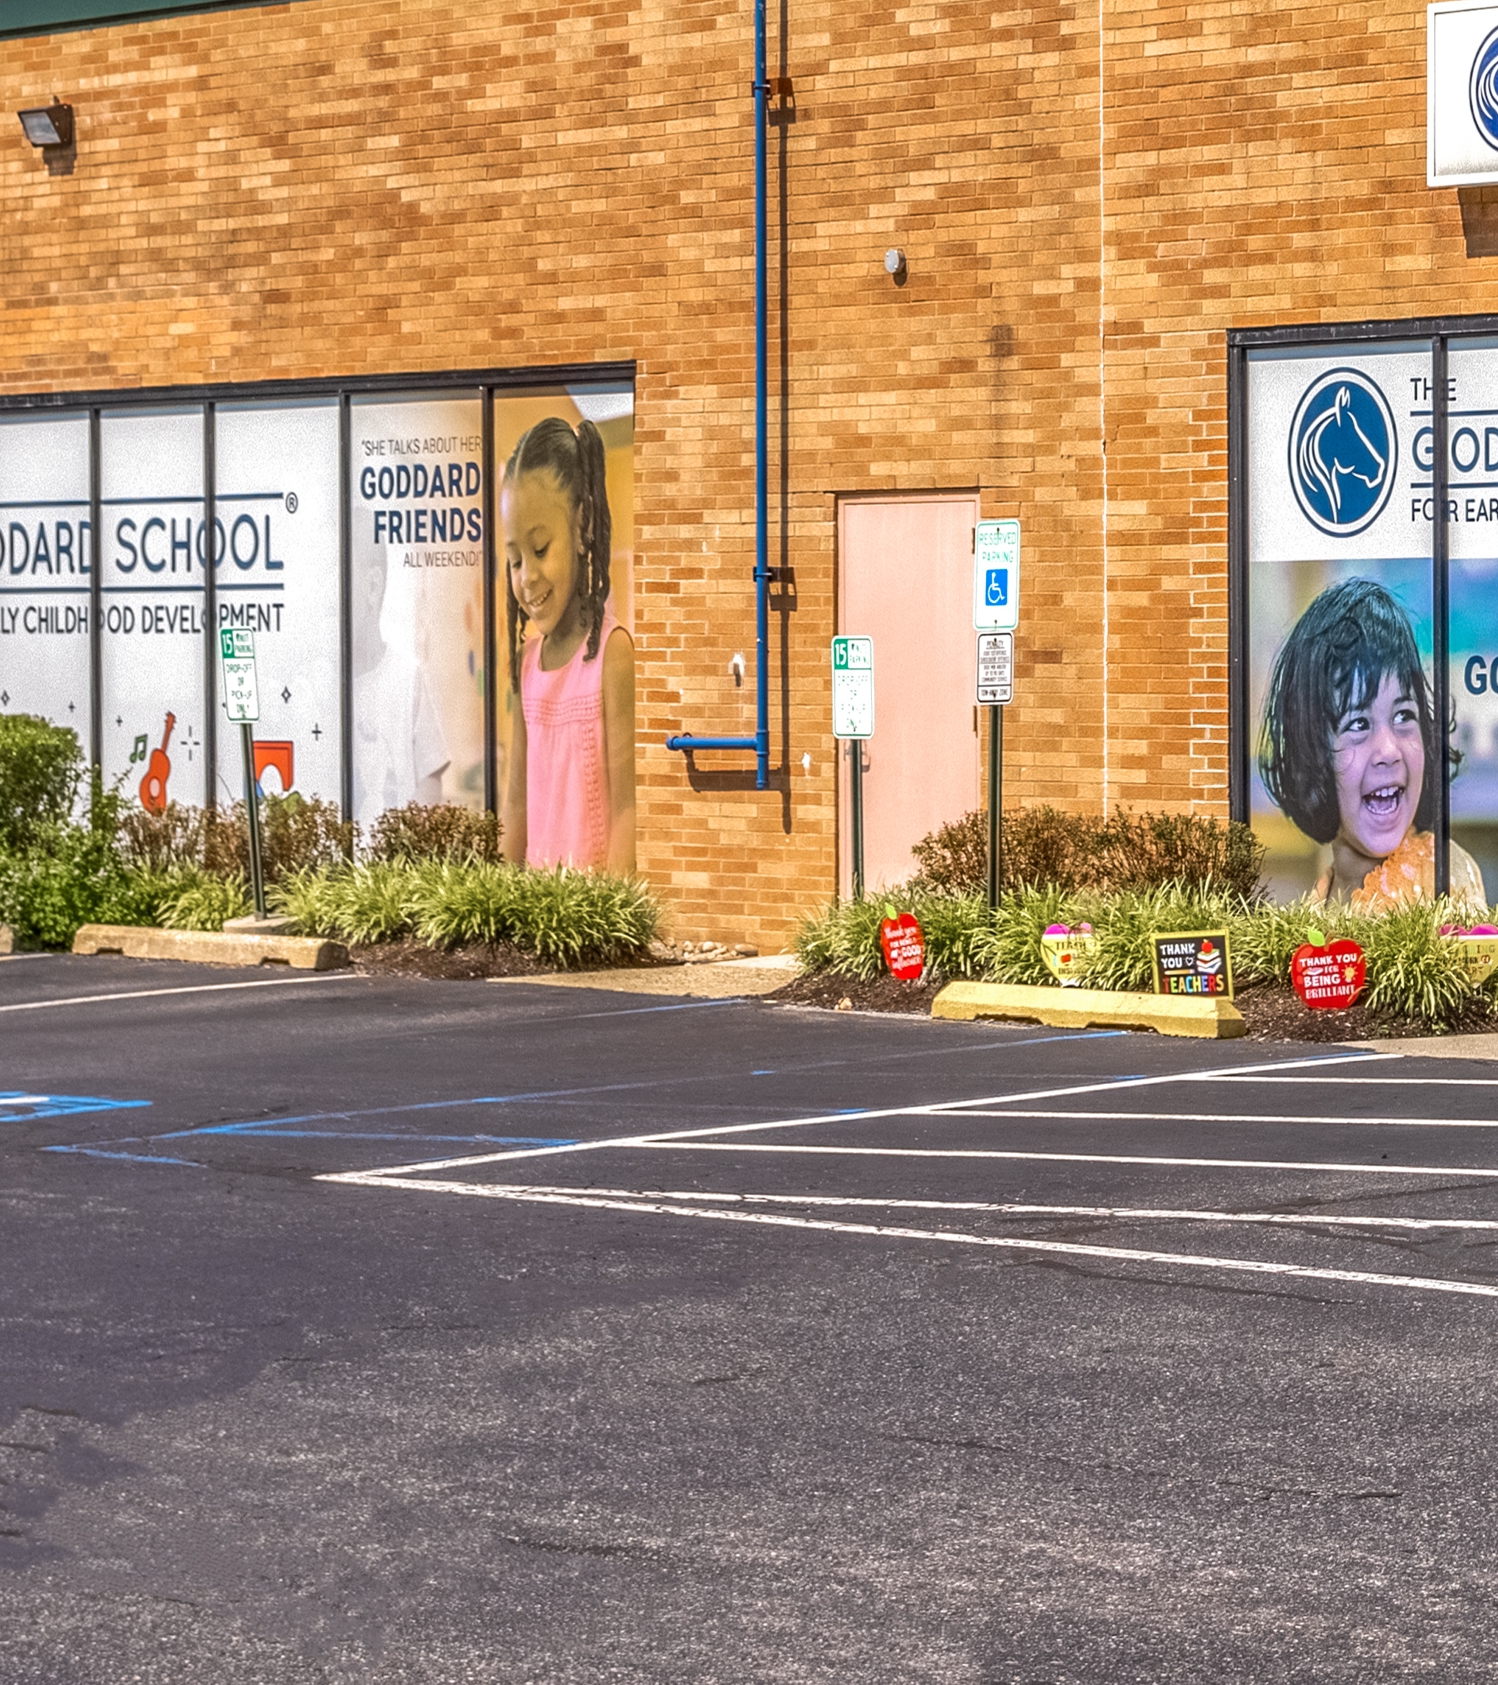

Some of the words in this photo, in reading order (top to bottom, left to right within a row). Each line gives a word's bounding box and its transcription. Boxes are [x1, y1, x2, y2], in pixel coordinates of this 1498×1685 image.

[1410, 377, 1456, 401] THE
[388, 438, 420, 455] TALKS
[422, 436, 458, 454] ABOUT
[360, 461, 481, 500] GODDARD
[1411, 497, 1459, 522] FOR
[374, 507, 482, 544] FRIENDS
[979, 532, 1016, 545] RESERVED
[403, 552, 423, 568] ALL
[982, 550, 1013, 563] PARKING
[23, 605, 135, 634] CHILDHOD
[142, 603, 284, 634] DEVELPMENT
[222, 633, 233, 655] 15
[835, 643, 847, 666] 15
[902, 945, 921, 957] GOOD
[1159, 943, 1196, 955] THANK
[1161, 957, 1182, 969] YOU
[1299, 955, 1333, 967] THANK
[1336, 953, 1357, 963] YOU
[1163, 974, 1225, 993] TEACHERS
[1303, 974, 1341, 988] BEING
[1305, 984, 1355, 999] BRILLIANT
